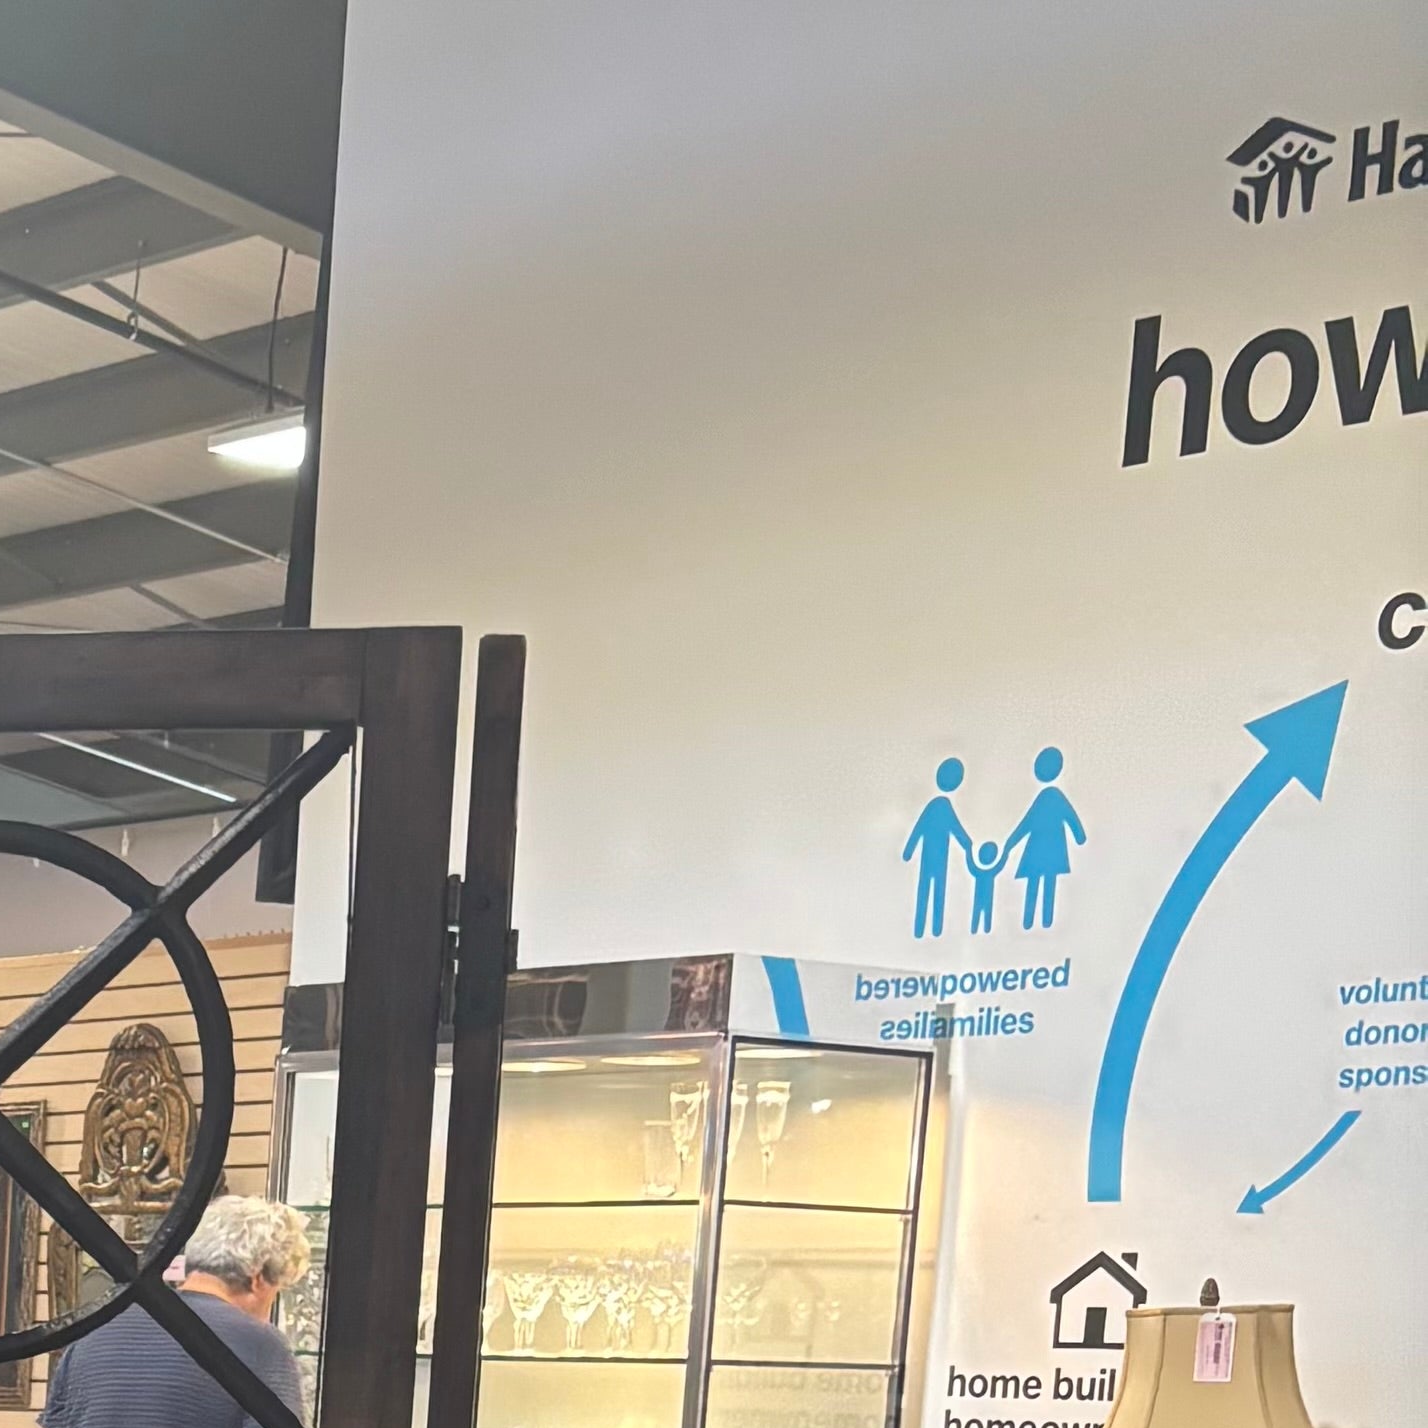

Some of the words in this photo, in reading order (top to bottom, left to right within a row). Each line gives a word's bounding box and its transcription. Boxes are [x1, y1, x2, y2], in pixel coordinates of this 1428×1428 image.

[1348, 119, 1428, 202] Ha
[1122, 304, 1428, 467] how
[1339, 975, 1428, 1005] volunt
[1339, 1065, 1428, 1093] spons
[947, 1365, 1042, 1399] home
[1053, 1367, 1116, 1401] buil
